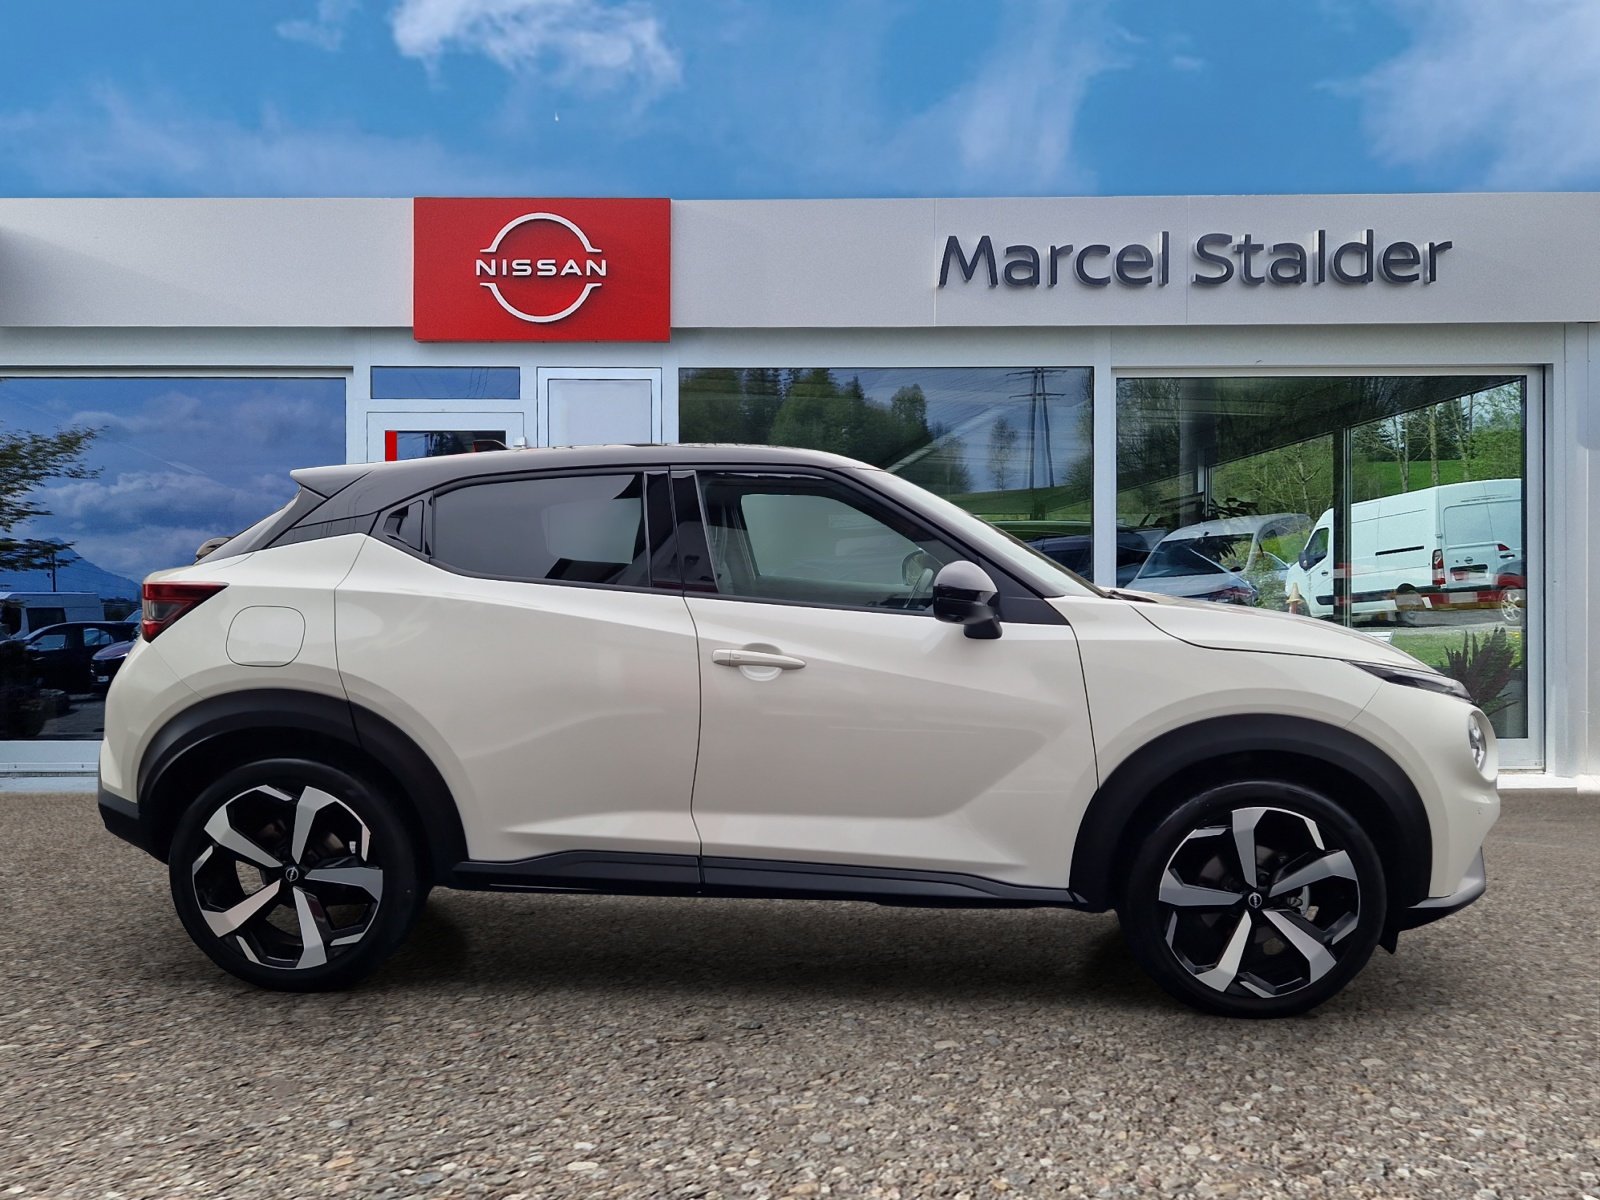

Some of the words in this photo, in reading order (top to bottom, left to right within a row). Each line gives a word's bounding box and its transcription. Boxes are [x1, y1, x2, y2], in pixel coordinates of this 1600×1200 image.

[475, 259, 607, 276] NISSAN
[937, 231, 1170, 288] Marcel
[1191, 229, 1453, 285] Stalder
